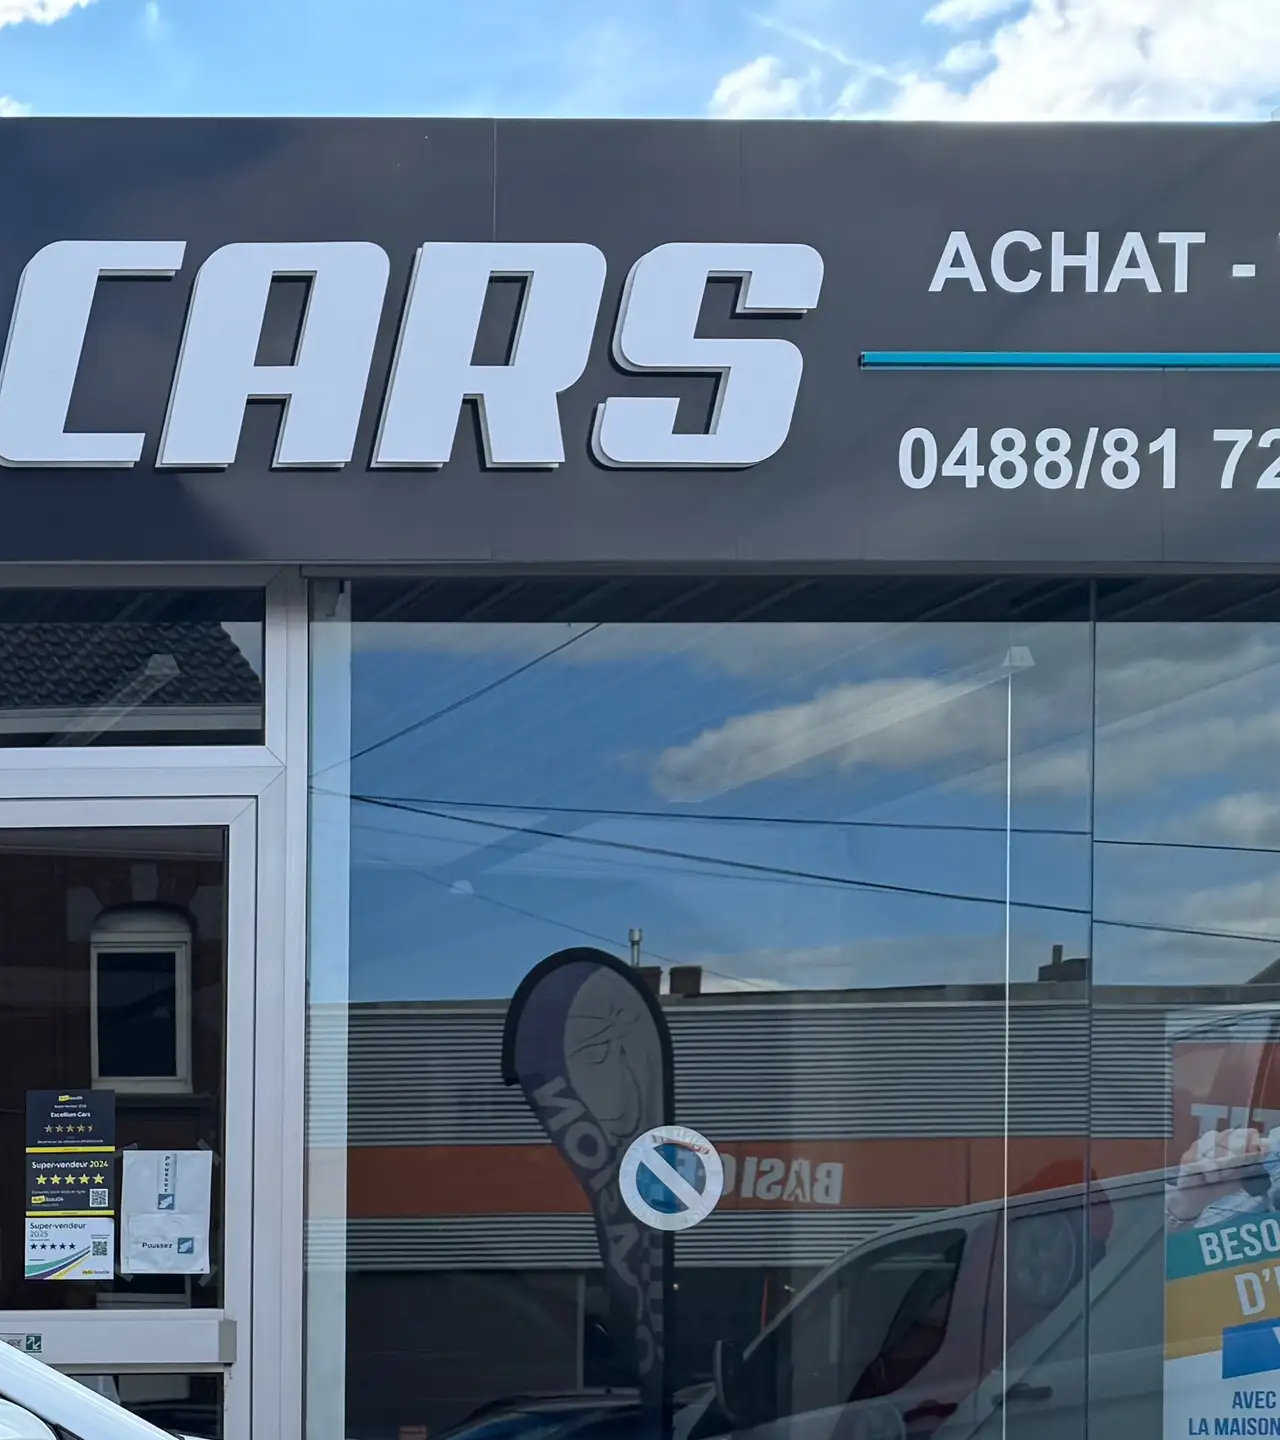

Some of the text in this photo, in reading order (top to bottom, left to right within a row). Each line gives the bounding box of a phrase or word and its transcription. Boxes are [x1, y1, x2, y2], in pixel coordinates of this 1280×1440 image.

[928, 231, 1207, 294] ACHAT
[898, 427, 1177, 490] 0488/81
[31, 1160, 109, 1170] Super-vendeur 2024
[29, 1222, 87, 1230] Super-vendeur
[1232, 1391, 1276, 1409] AVEC
[1188, 1417, 1210, 1436] LA
